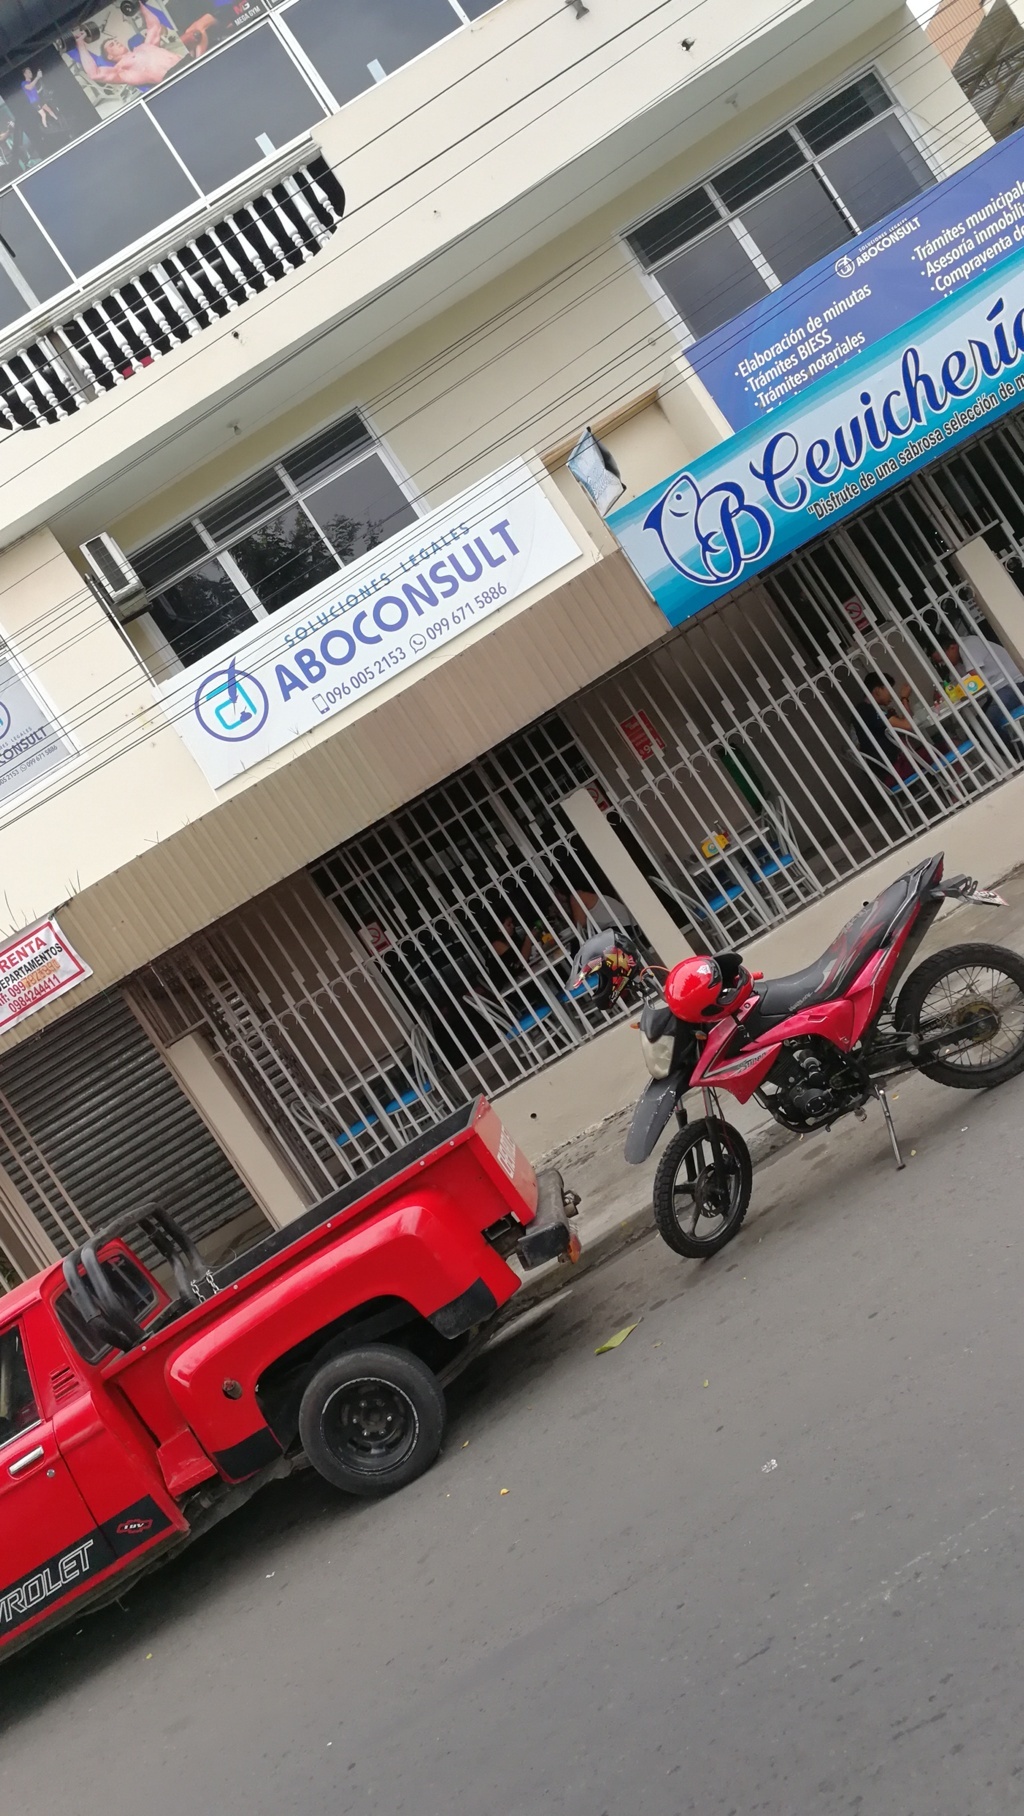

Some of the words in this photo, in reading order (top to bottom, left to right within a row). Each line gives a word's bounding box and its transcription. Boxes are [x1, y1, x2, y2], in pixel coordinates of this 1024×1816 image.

[234, 13, 250, 26] MEGA
[248, 5, 261, 17] GYM
[855, 216, 921, 267] ABOCONSULT
[913, 222, 966, 261] Trámites
[925, 238, 976, 278] Asesoría
[935, 236, 1013, 291] Compraventa
[738, 328, 806, 378] Elaboración
[806, 316, 823, 334] de
[822, 283, 872, 322] minutas
[747, 353, 799, 392] Trámites
[797, 328, 832, 361] BIESS
[757, 368, 808, 408] Trámites
[808, 331, 866, 376] notariales
[807, 481, 860, 520] "Disfrute
[858, 472, 876, 491] de
[875, 457, 899, 482] una
[898, 428, 945, 466] sabrosa
[943, 392, 999, 437] selección
[999, 381, 1016, 402] de
[275, 518, 520, 703] ABOCONSULT
[284, 572, 391, 648] SOLUCIONES
[400, 521, 470, 573] LEGALES
[326, 682, 351, 704] 096
[350, 666, 375, 689] 005
[373, 646, 407, 675] 2153
[426, 617, 450, 640] 099
[452, 602, 475, 624] 671
[474, 582, 507, 609] 5886
[11, 726, 33, 743] LEGALES
[26, 758, 37, 768] 099
[36, 752, 46, 763] 671
[0, 936, 47, 974] RENTA
[8, 973, 61, 1013] 0984244411
